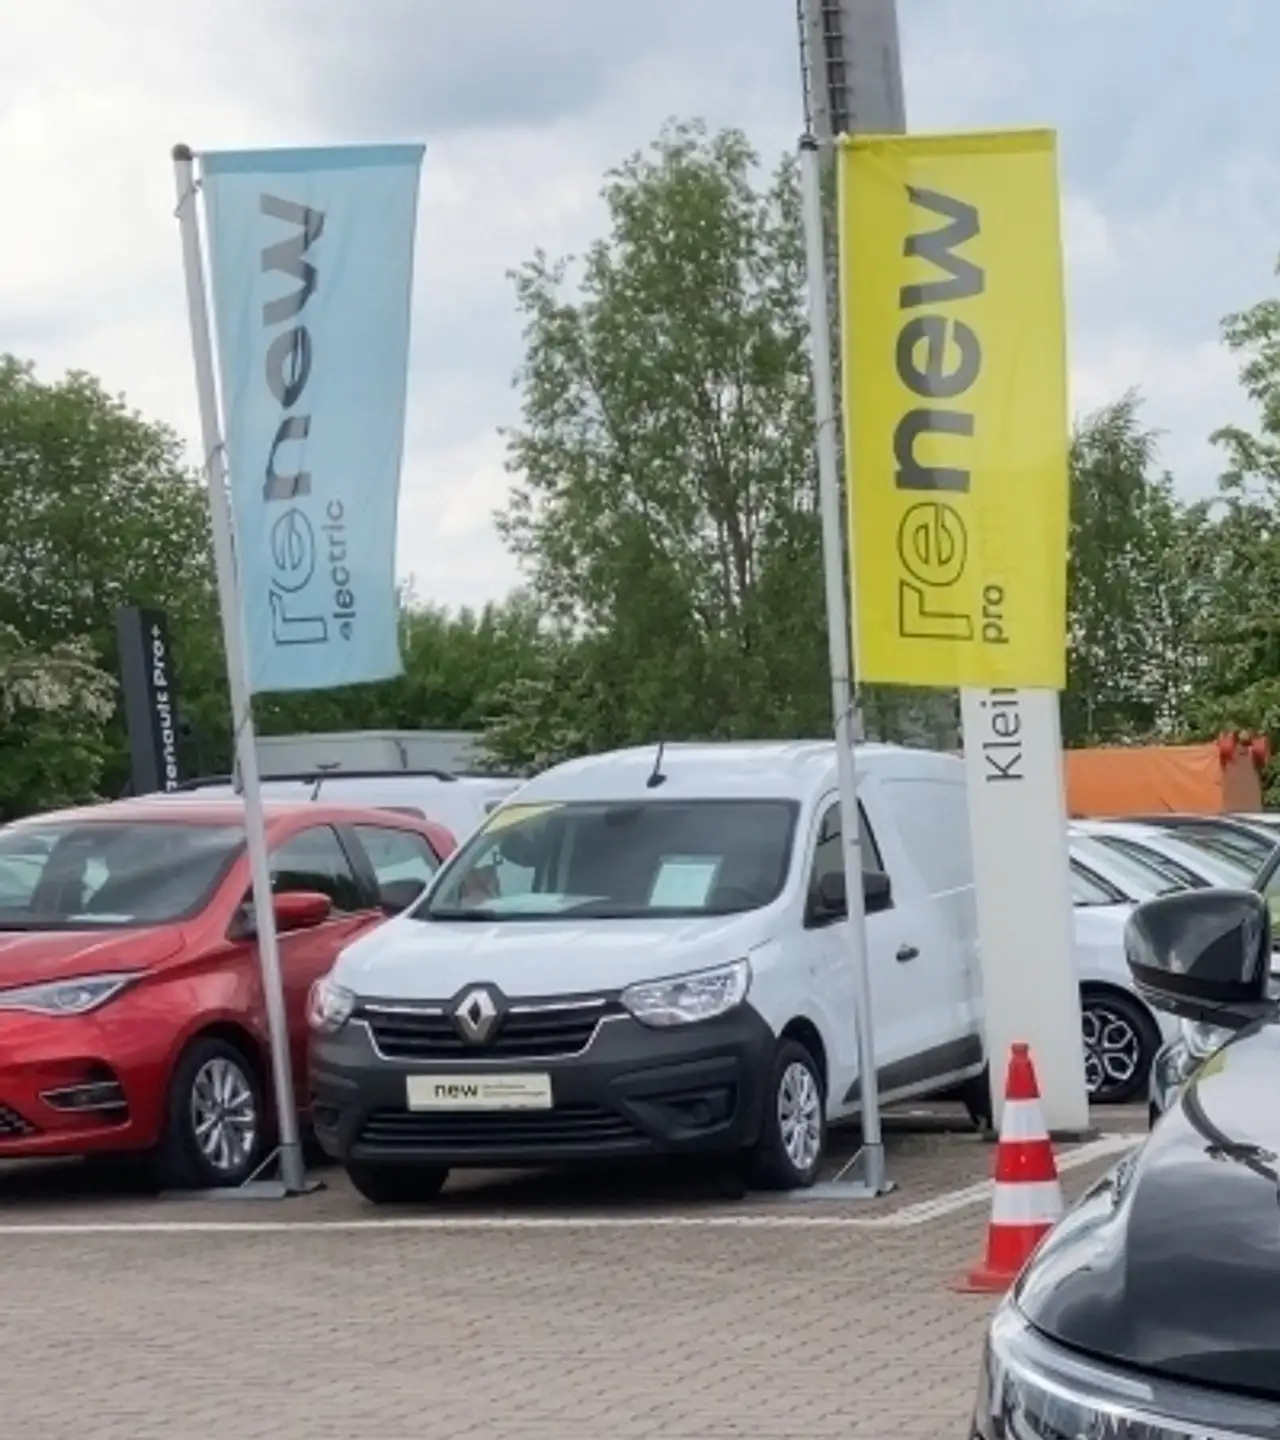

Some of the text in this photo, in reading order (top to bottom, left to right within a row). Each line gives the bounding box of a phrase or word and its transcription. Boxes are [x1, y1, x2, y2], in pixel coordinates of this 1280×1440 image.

[259, 193, 328, 647] renew
[893, 183, 985, 642] renew
[321, 499, 356, 642] electric
[982, 584, 1010, 645] pro
